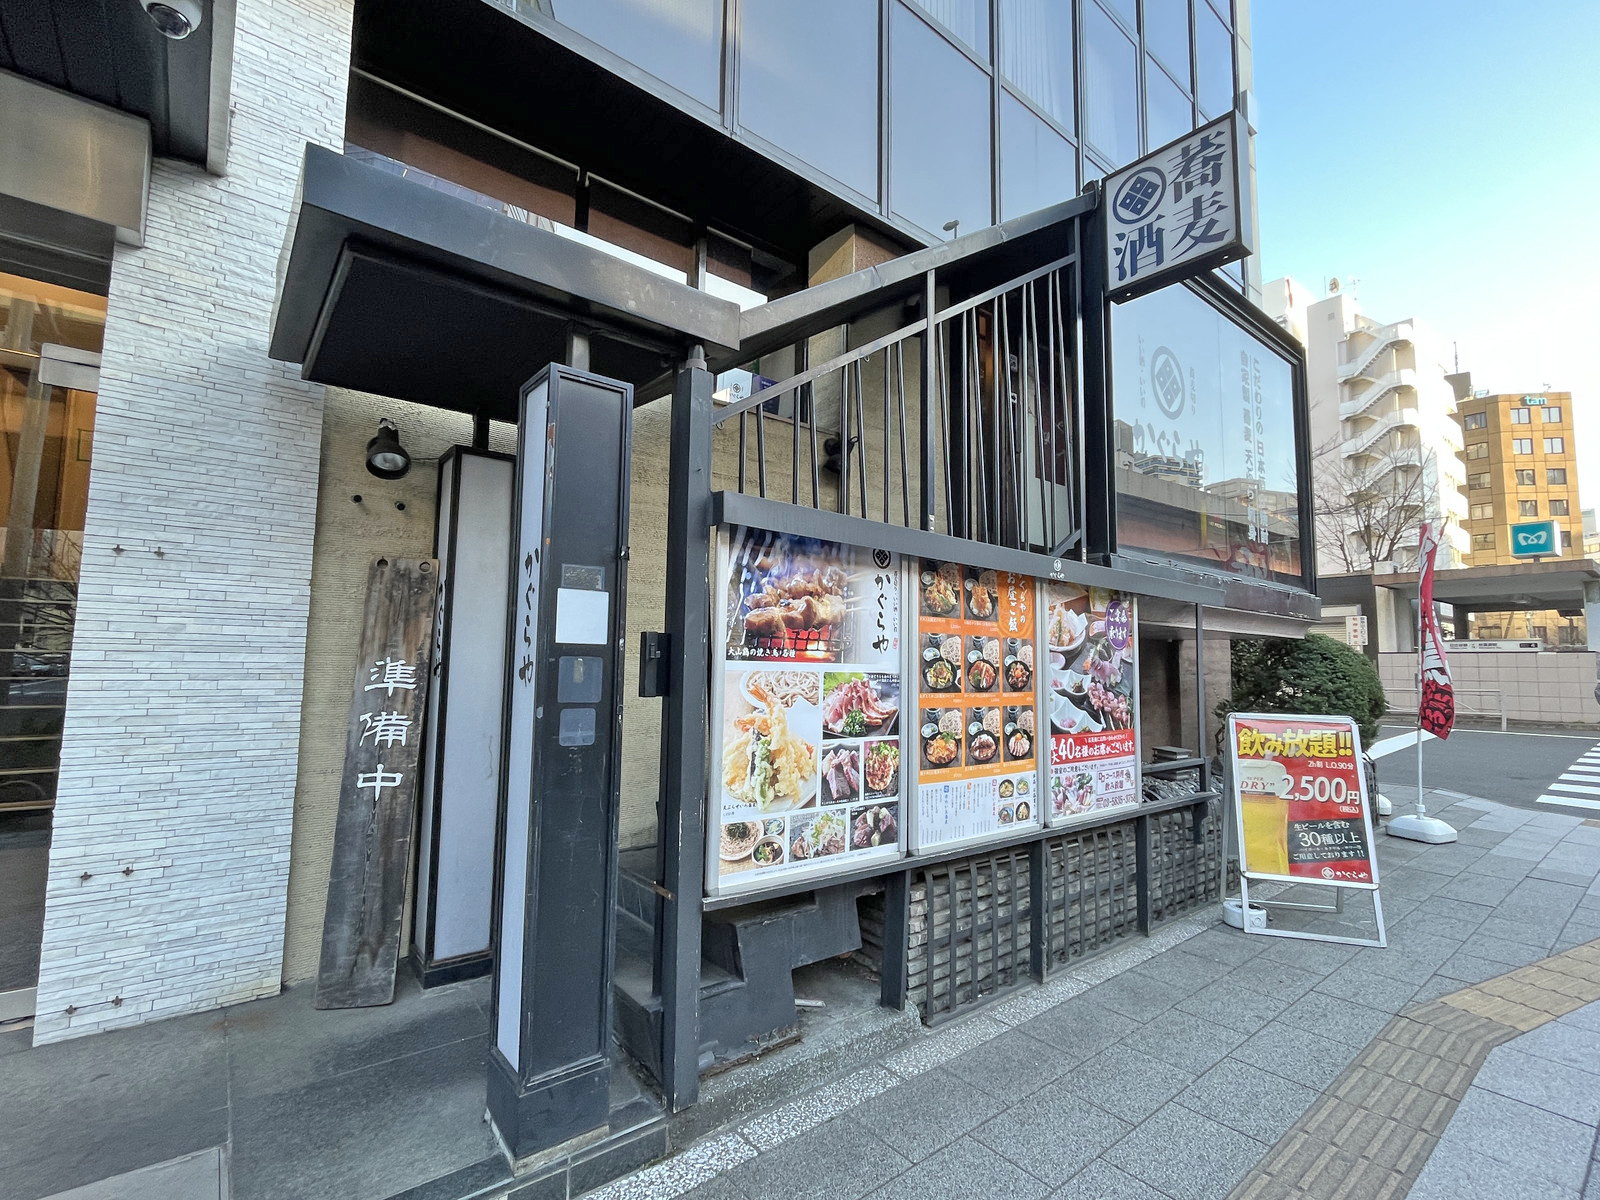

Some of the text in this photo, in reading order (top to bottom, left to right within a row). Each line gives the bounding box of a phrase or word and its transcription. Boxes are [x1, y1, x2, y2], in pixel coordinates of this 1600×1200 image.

[1167, 131, 1230, 261] 蕎麦
[1113, 214, 1166, 281] 酒
[1524, 395, 1547, 405] tam
[519, 547, 540, 687] かぐらや
[872, 573, 891, 654] かぐらや
[1019, 574, 1028, 623] ぐらやの
[356, 656, 418, 801] 準備中
[1294, 821, 1350, 831] 生ビールを含む
[1298, 831, 1361, 847] 30種以上
